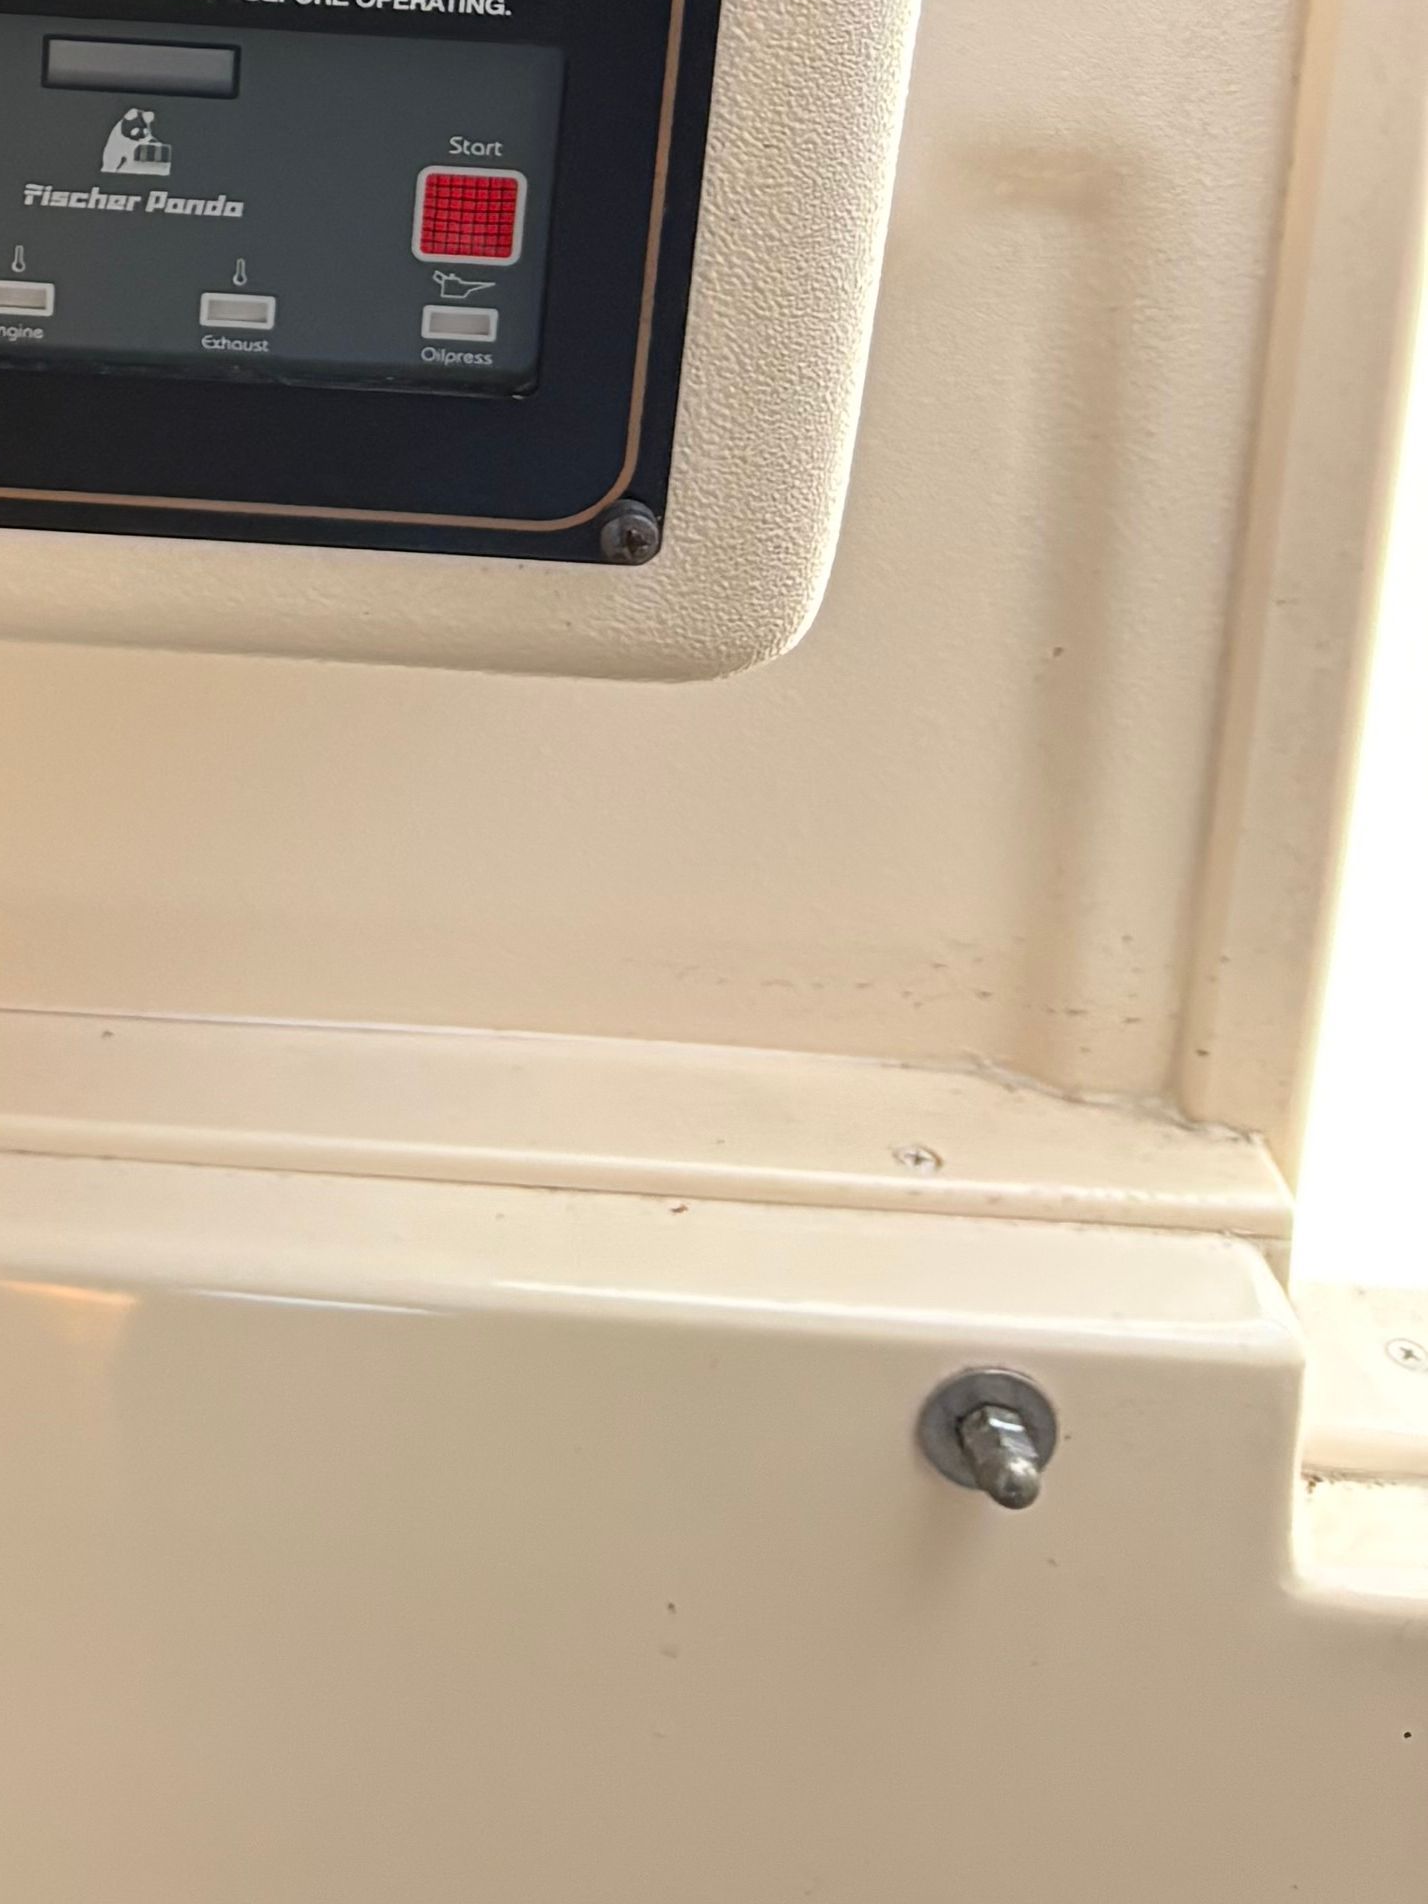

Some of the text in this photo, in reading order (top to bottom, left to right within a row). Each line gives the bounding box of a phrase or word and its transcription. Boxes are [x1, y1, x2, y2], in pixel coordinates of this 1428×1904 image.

[449, 137, 502, 156] Start
[24, 184, 243, 217] Fischer Panda
[202, 335, 268, 352] Exhaust
[421, 347, 492, 365] Oilpress
